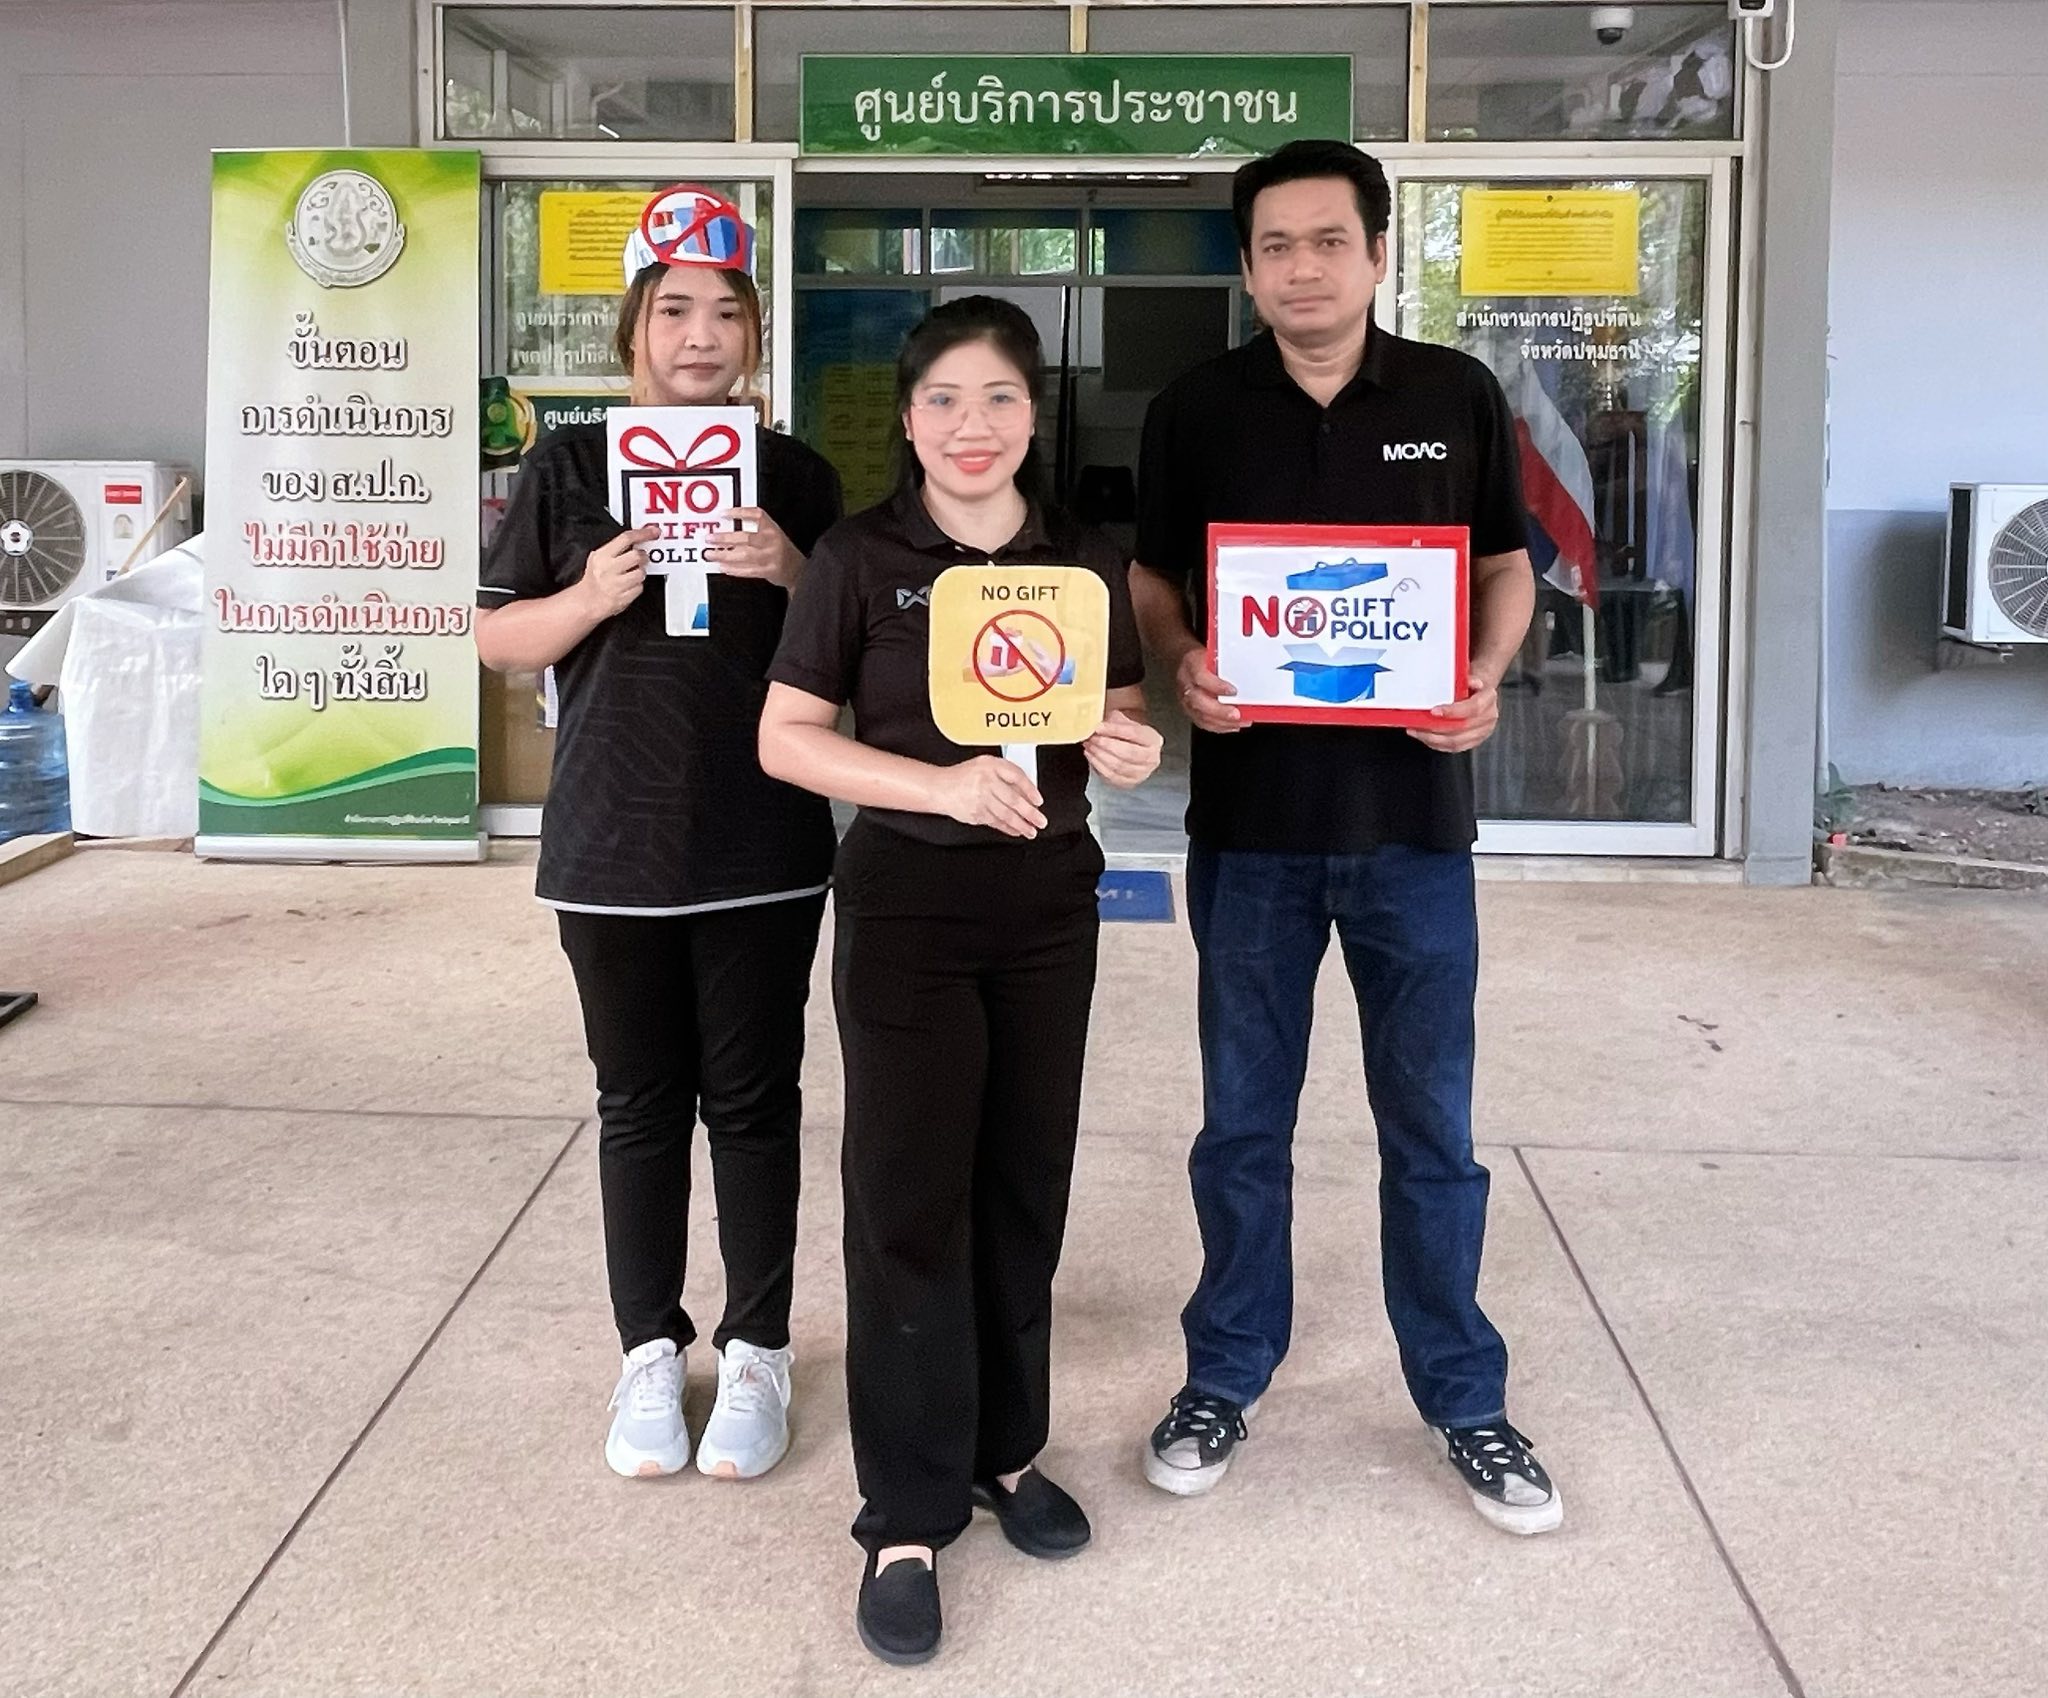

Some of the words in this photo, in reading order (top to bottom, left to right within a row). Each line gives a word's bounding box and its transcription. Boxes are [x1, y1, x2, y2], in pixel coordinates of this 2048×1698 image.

[854, 71, 1298, 142] ศูนย์บริการประชาชน
[288, 311, 404, 365] ขั้นตอน
[241, 394, 452, 430] การดำเนินการ
[1382, 441, 1447, 461] MOAC
[262, 470, 320, 496] ของ
[332, 458, 427, 497] ส.ป.ก.
[643, 480, 720, 514] NO
[244, 521, 442, 563] ไม่มีค่าใช้จ่าย
[214, 588, 470, 630] ในการดำเนินการ
[982, 585, 1011, 601] NO
[1016, 585, 1060, 601] GIFT
[1330, 597, 1396, 617] GIFT
[1330, 620, 1429, 641] POLICY
[332, 644, 422, 696] ทั้งสิ้น
[985, 711, 1052, 728] POLICY
